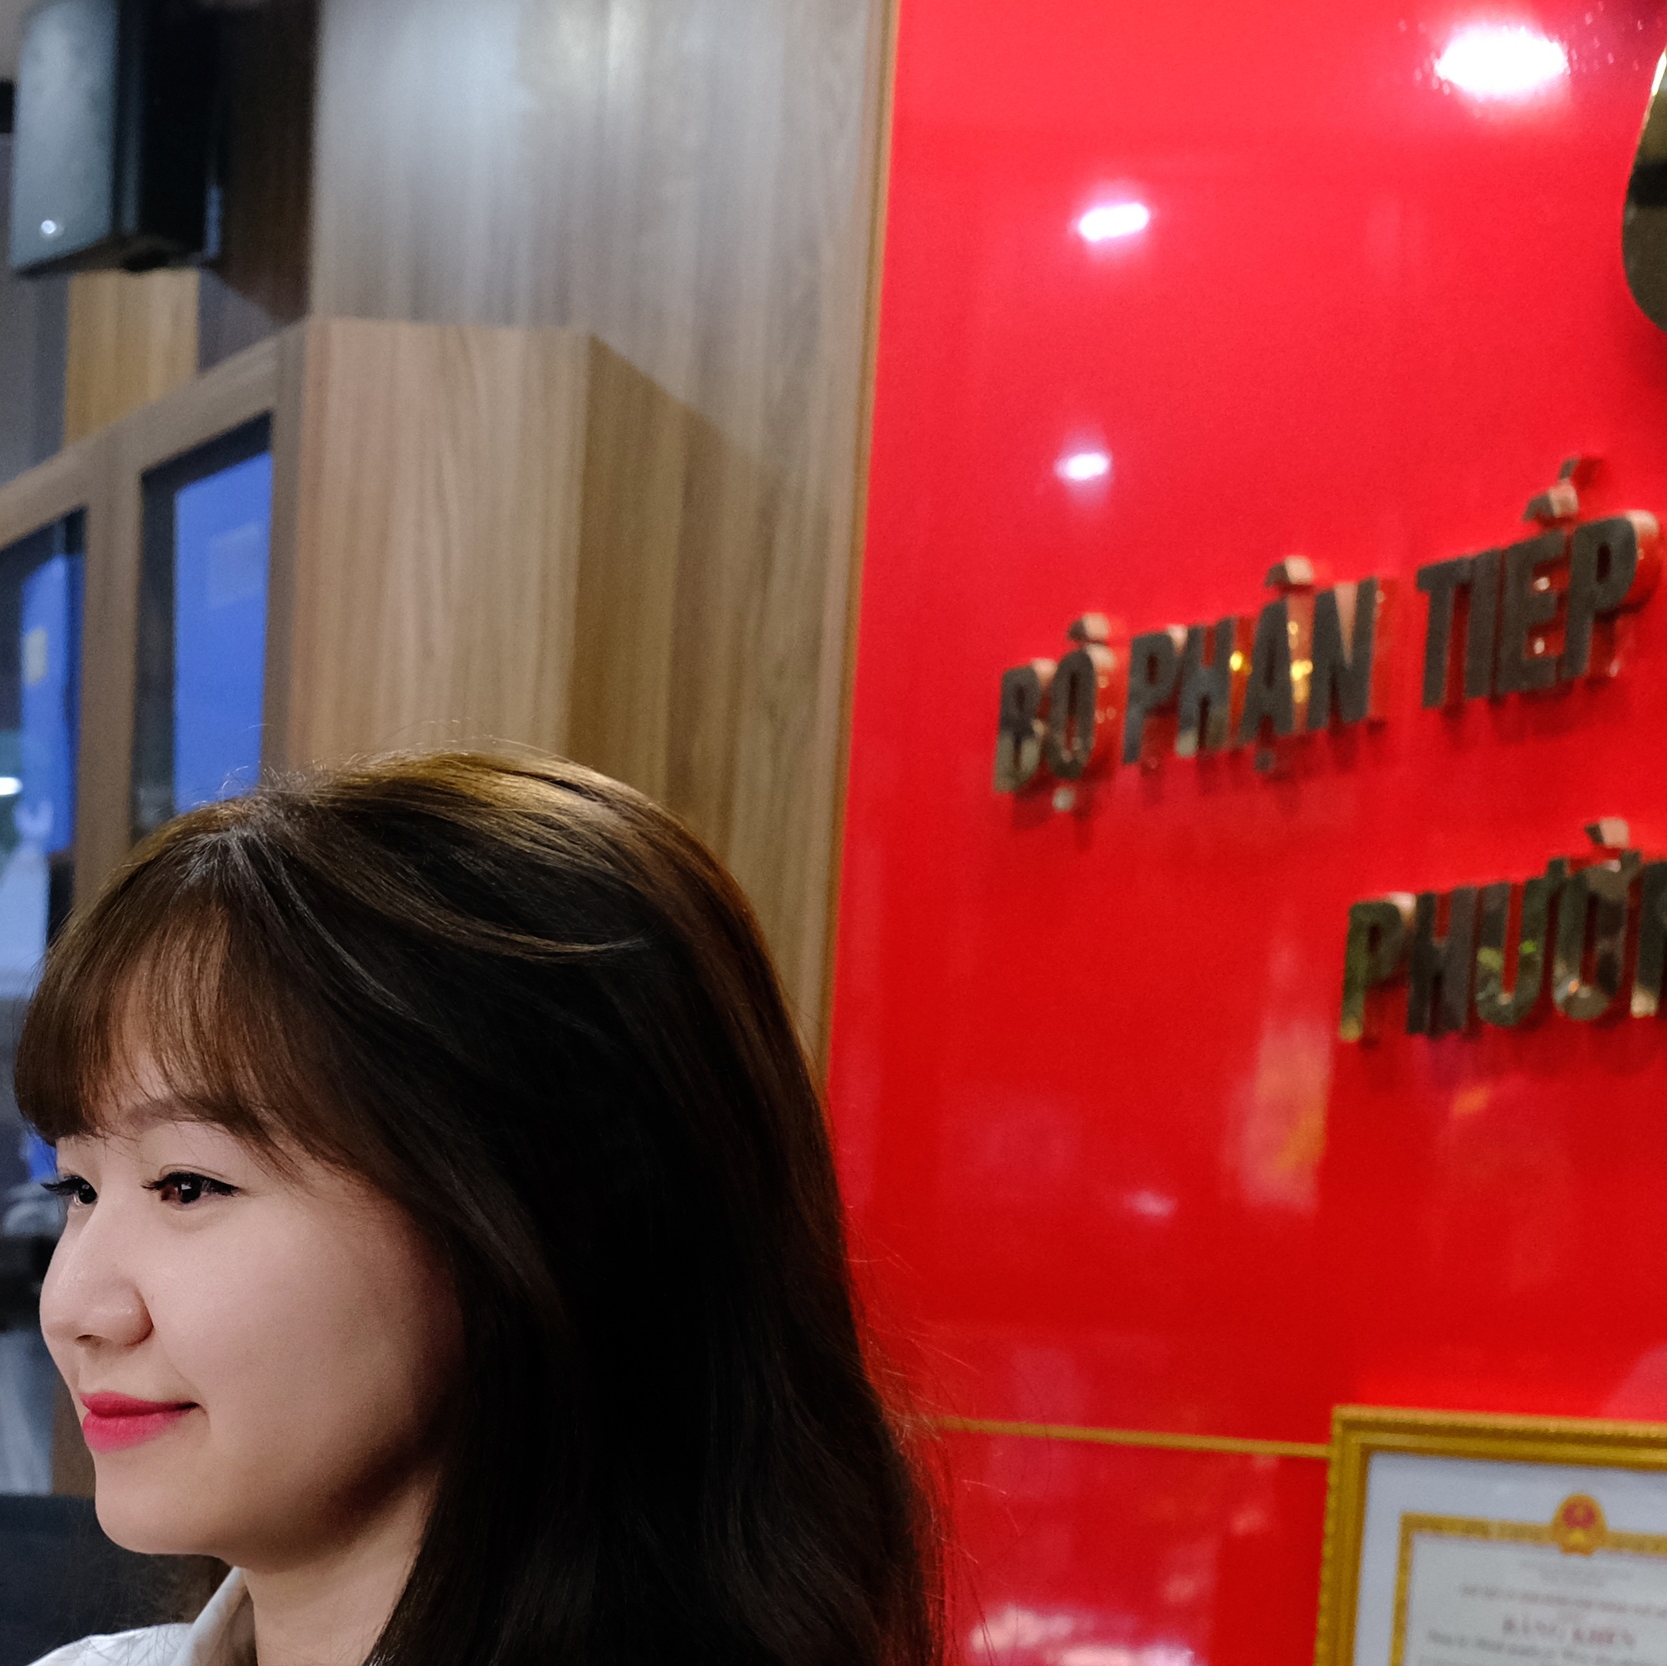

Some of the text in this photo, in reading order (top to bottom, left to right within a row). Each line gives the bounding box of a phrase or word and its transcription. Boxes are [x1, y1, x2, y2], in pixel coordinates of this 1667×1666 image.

[993, 457, 1657, 812] BỘ PHẬN TIẾP
